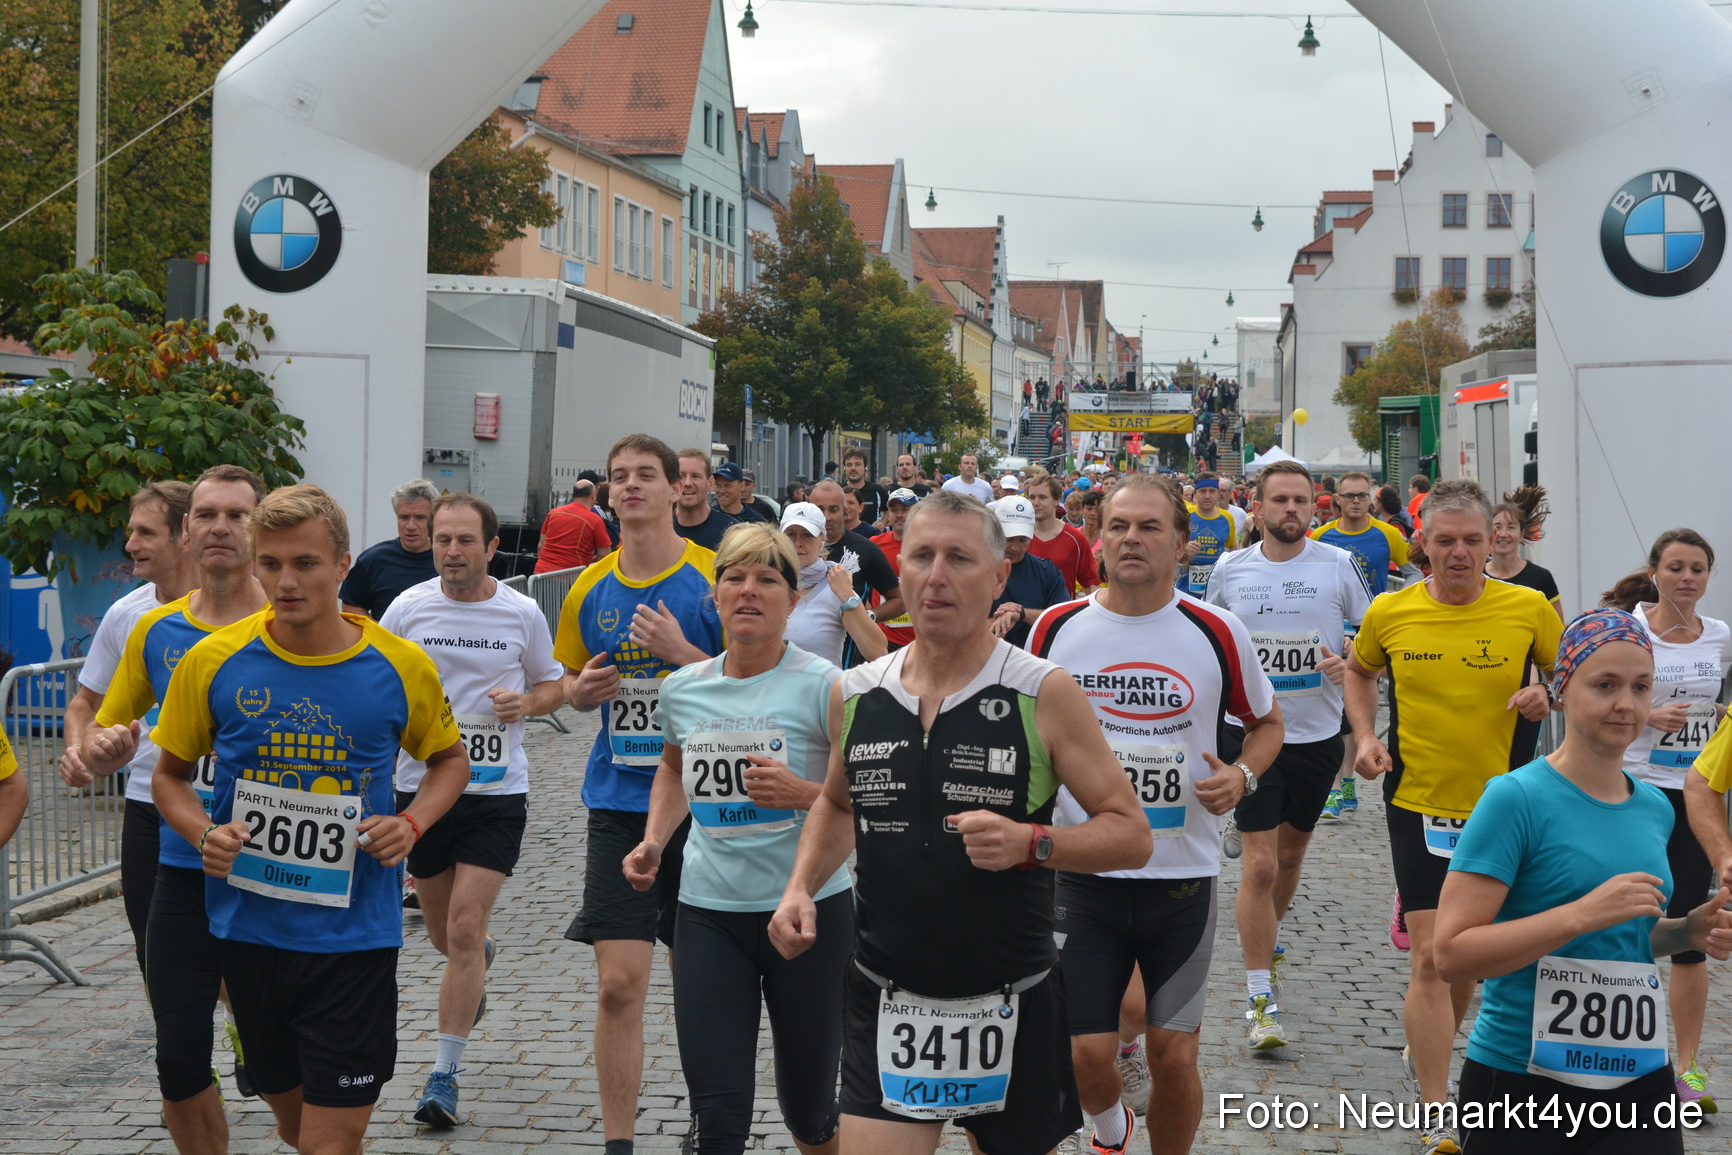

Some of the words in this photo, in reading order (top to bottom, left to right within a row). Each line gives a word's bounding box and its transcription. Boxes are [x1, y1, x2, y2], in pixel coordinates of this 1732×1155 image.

[241, 176, 334, 217] BMW
[1610, 172, 1718, 216] BMW
[679, 379, 708, 423] BOCK
[1109, 417, 1152, 428] START
[1238, 585, 1273, 593] PEUGEOT
[1284, 587, 1318, 595] DESIGN
[1240, 592, 1270, 601] MÜLLER
[423, 636, 507, 651] www.hasit.de
[1257, 647, 1317, 672] 2404
[1403, 651, 1444, 661] Dieter
[1466, 661, 1504, 670] Burgthann
[1694, 662, 1715, 670] HECK
[249, 689, 259, 697] 15
[1171, 683, 1180, 691] &
[243, 698, 263, 706] Jahre
[1114, 691, 1182, 708] JÄNIG
[457, 722, 496, 731] Neumarkt
[1104, 722, 1151, 736] sportliche
[1152, 720, 1193, 736] Autohaus
[686, 743, 715, 753] PARTL
[717, 742, 765, 753] Neumarkt
[849, 753, 890, 763] TRAINING
[953, 757, 985, 766] Industrial
[1127, 753, 1173, 764] Neumarkt
[259, 760, 323, 772] 21.September
[949, 763, 984, 772] Consulting
[942, 782, 1014, 797] Fahrschule
[236, 790, 276, 808] PARTL
[279, 799, 338, 817] Neumarkt
[947, 793, 977, 803] Schuster
[986, 796, 1013, 806] Feistner
[718, 807, 757, 823] Karin
[242, 810, 346, 864] 2603
[264, 864, 312, 888] Oliver
[1540, 968, 1588, 984] PARTL
[1591, 973, 1646, 988] Neumarkt
[882, 1002, 927, 1016] PARTL
[930, 1008, 993, 1020] Neumarkt
[1548, 989, 1656, 1042] 2800
[1538, 1030, 1544, 1039] D
[891, 1022, 1003, 1070] 3410
[1565, 1049, 1637, 1072] Melanie
[352, 1074, 374, 1085] JAKO
[903, 1080, 978, 1104] KURT
